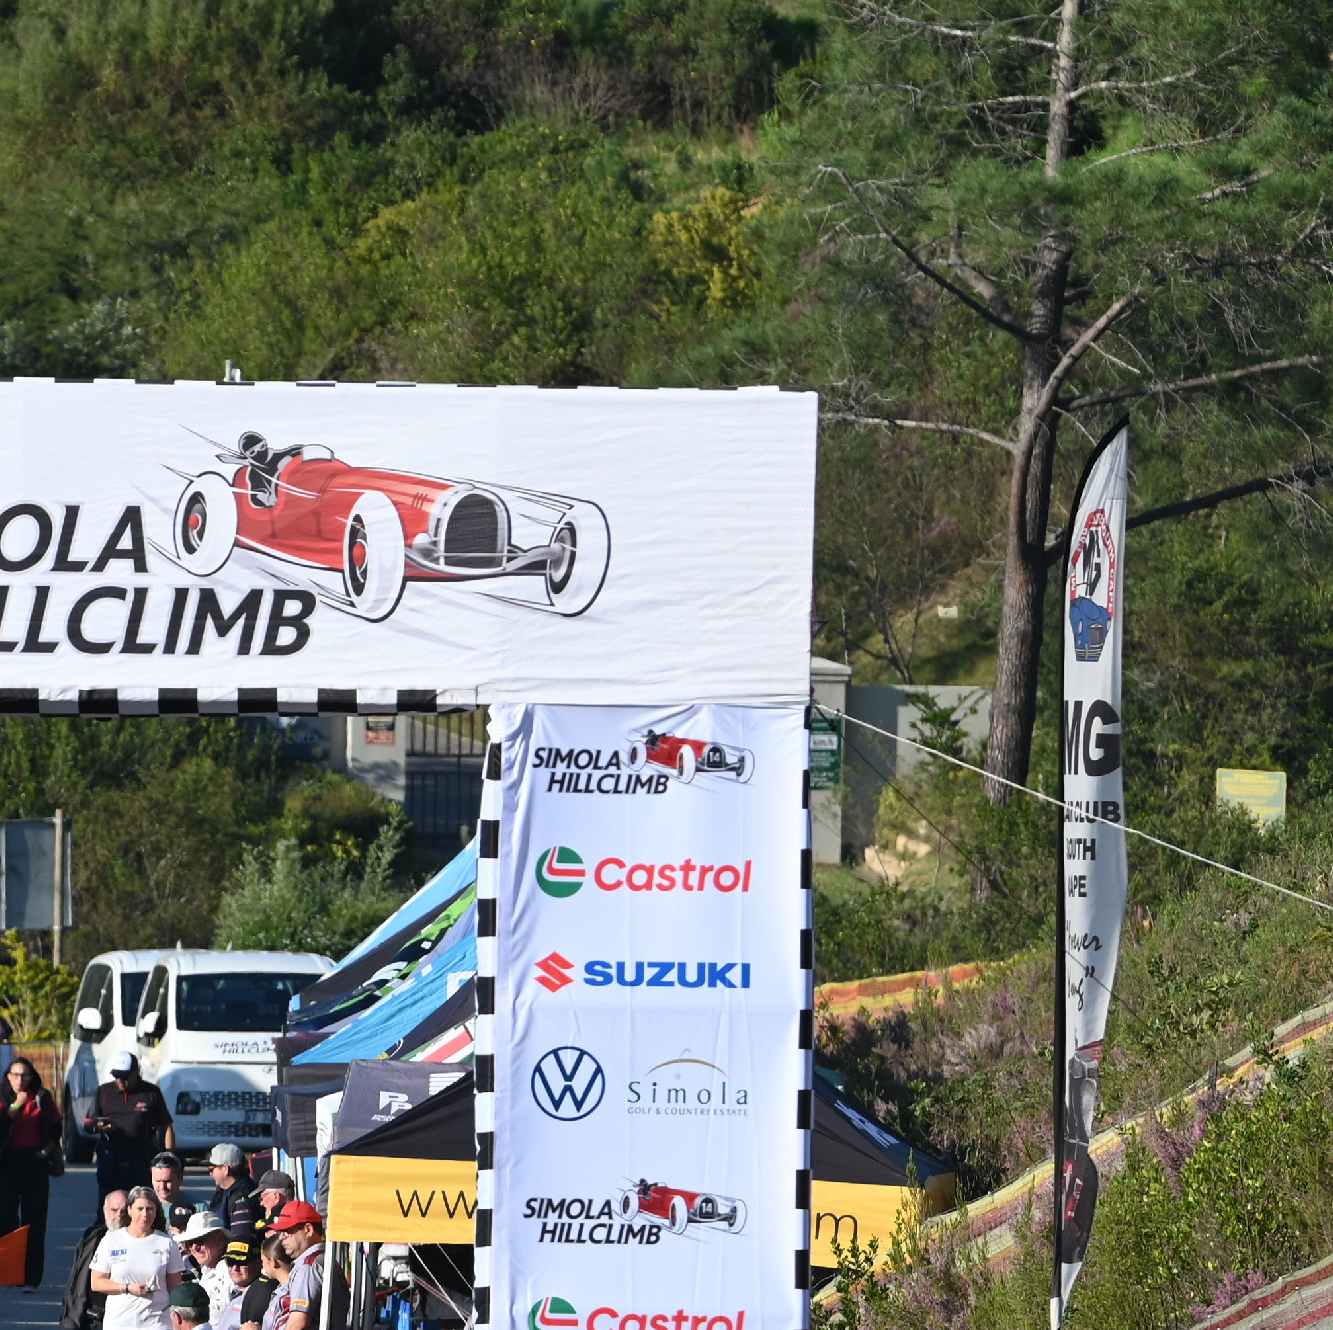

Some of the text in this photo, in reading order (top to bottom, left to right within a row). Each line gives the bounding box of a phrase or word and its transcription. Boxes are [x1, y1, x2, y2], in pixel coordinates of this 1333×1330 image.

[1064, 699, 1121, 777] MG
[532, 747, 622, 771] SIMOLA
[708, 751, 722, 765] 14
[547, 773, 669, 795] HILLCLIMB
[594, 857, 752, 893] Castrol
[583, 960, 751, 989] SUZUKI
[627, 1080, 748, 1106] Simola
[627, 1106, 749, 1117] GOLF & COUNTRY ESTATE
[523, 1197, 614, 1220] SIMOLA
[701, 1201, 714, 1215] 14
[538, 1223, 662, 1245] HILLCLIMB
